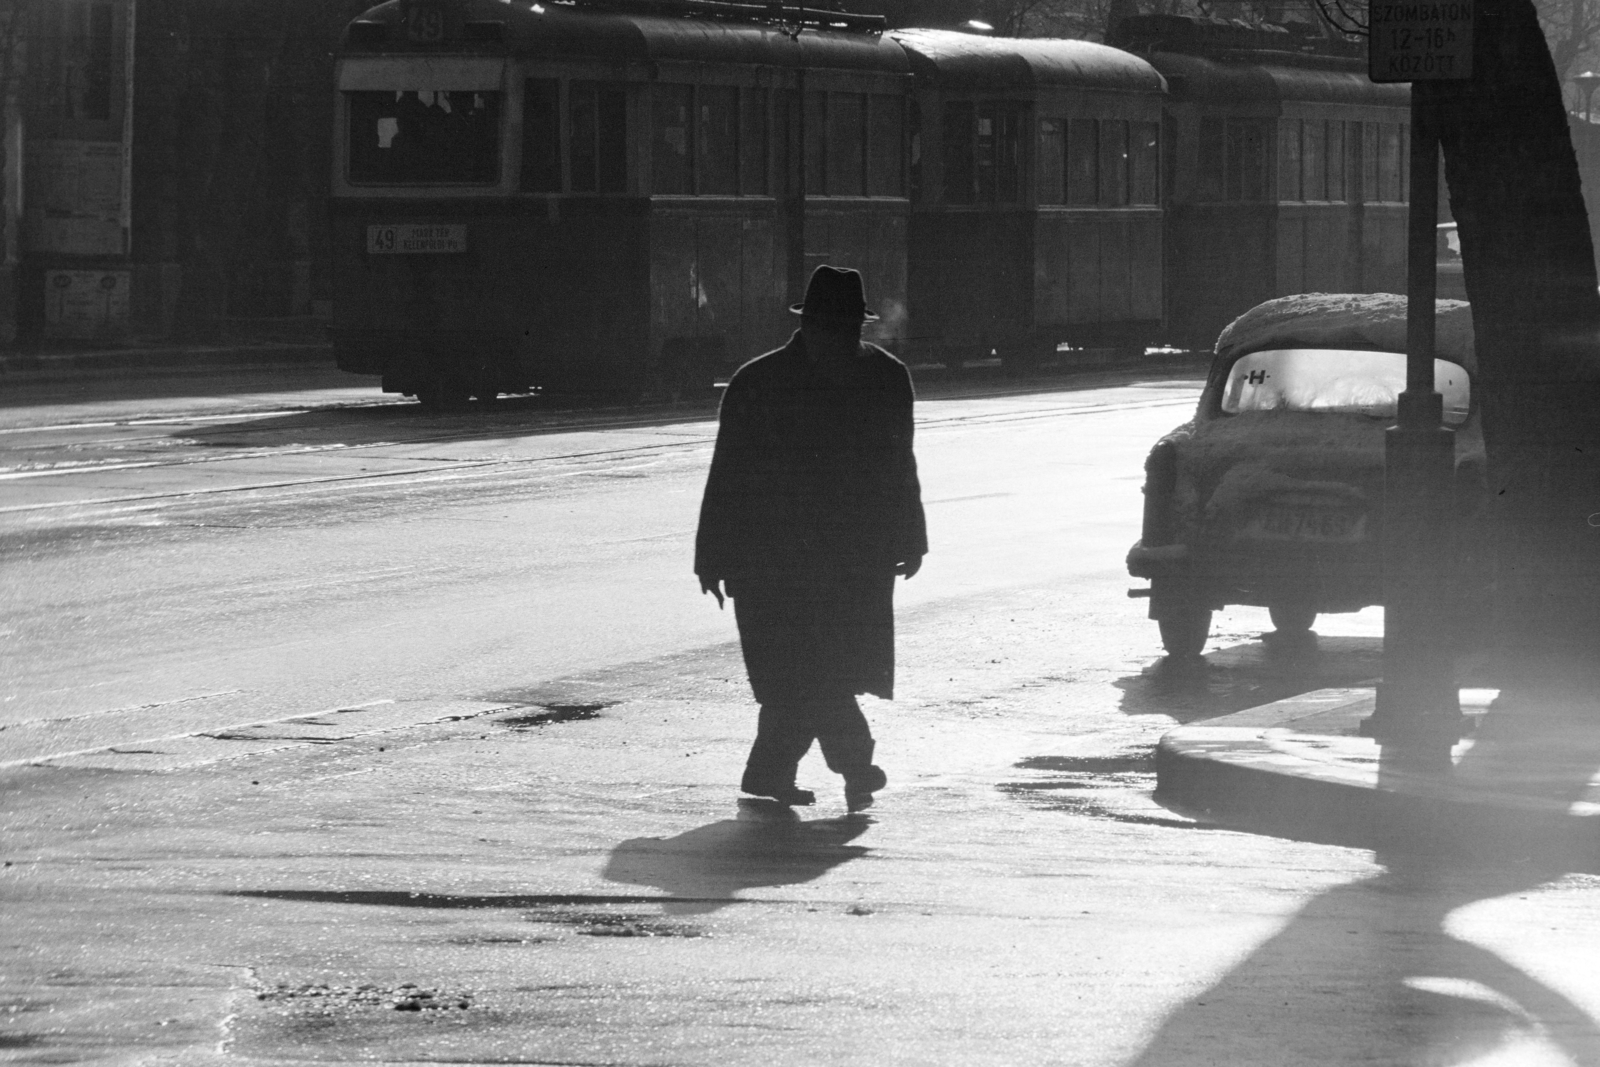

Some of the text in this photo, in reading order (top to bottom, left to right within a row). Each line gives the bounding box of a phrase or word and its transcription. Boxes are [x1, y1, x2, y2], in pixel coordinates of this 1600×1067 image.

[410, 8, 440, 38] 49
[1373, 2, 1471, 23] SZOMBATON
[1388, 52, 1455, 74] KÖZÖTT
[375, 229, 395, 250] 49
